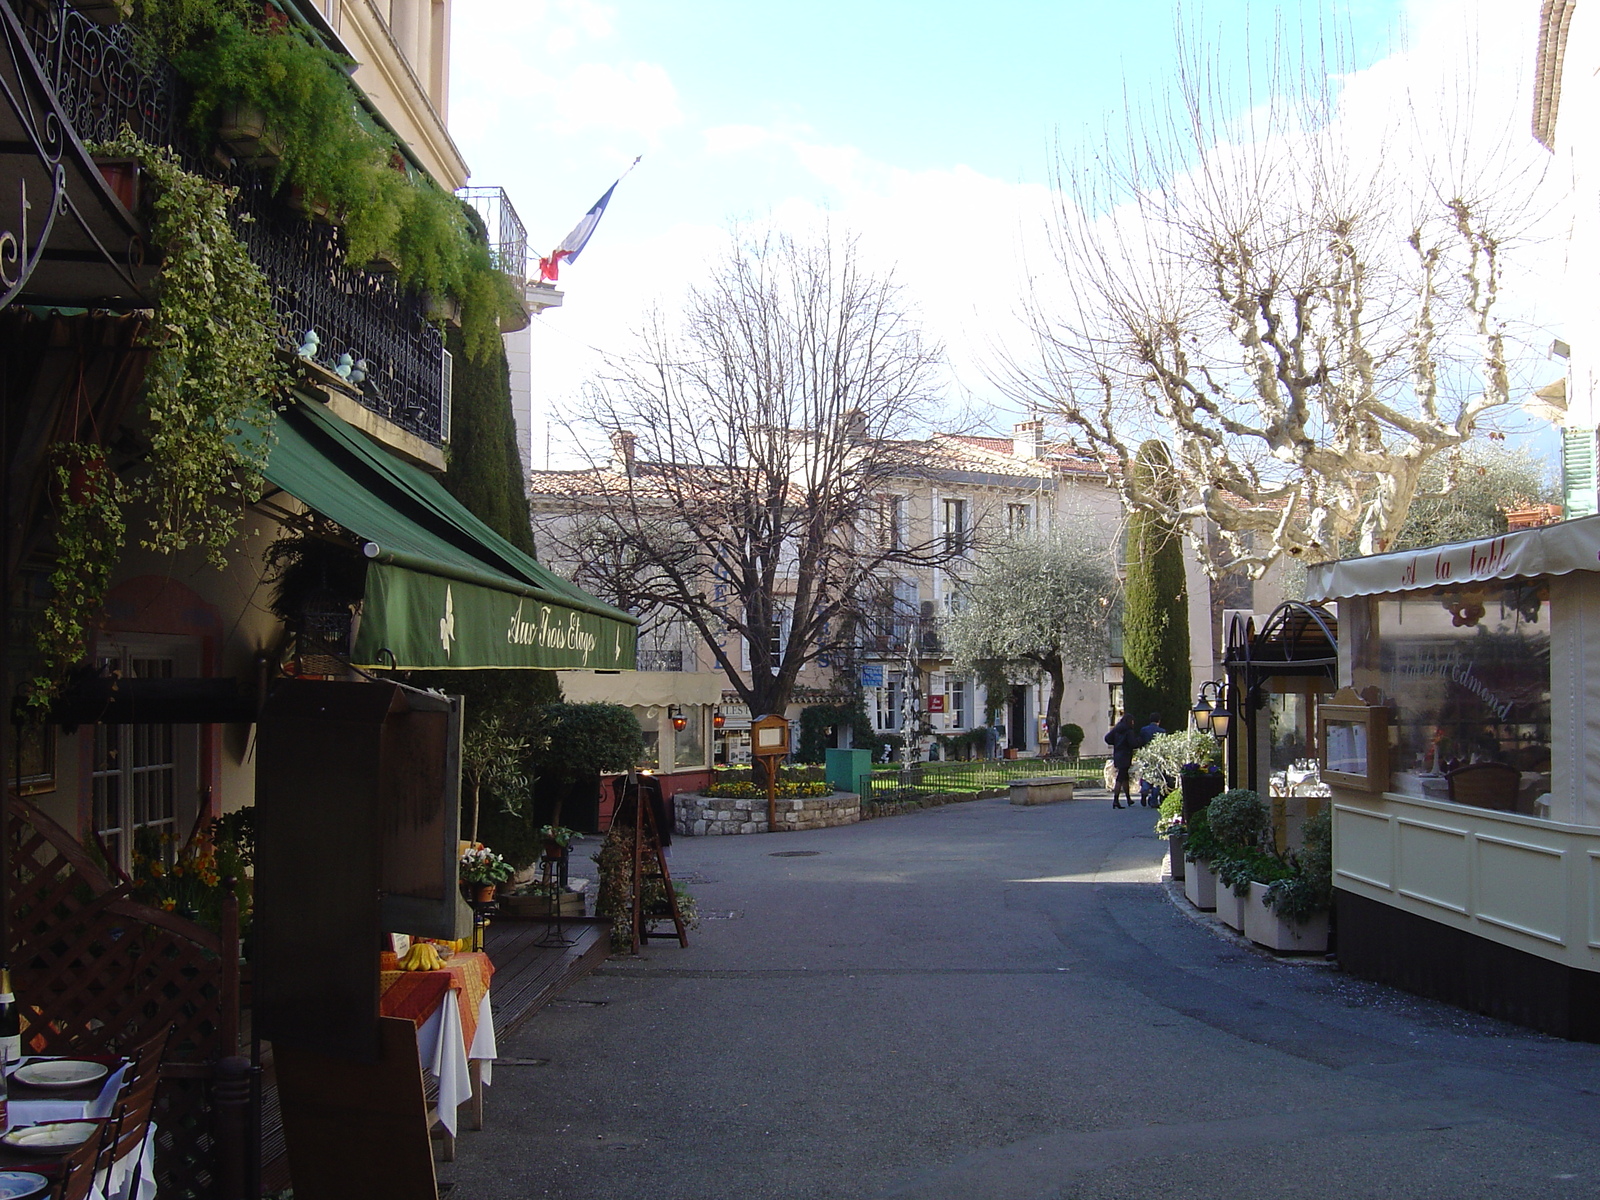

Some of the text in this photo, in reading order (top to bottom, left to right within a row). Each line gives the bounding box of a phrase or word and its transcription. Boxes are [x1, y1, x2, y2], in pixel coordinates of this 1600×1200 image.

[1402, 537, 1513, 586] A la table
[508, 599, 538, 645] Aux
[539, 606, 567, 649] Trois
